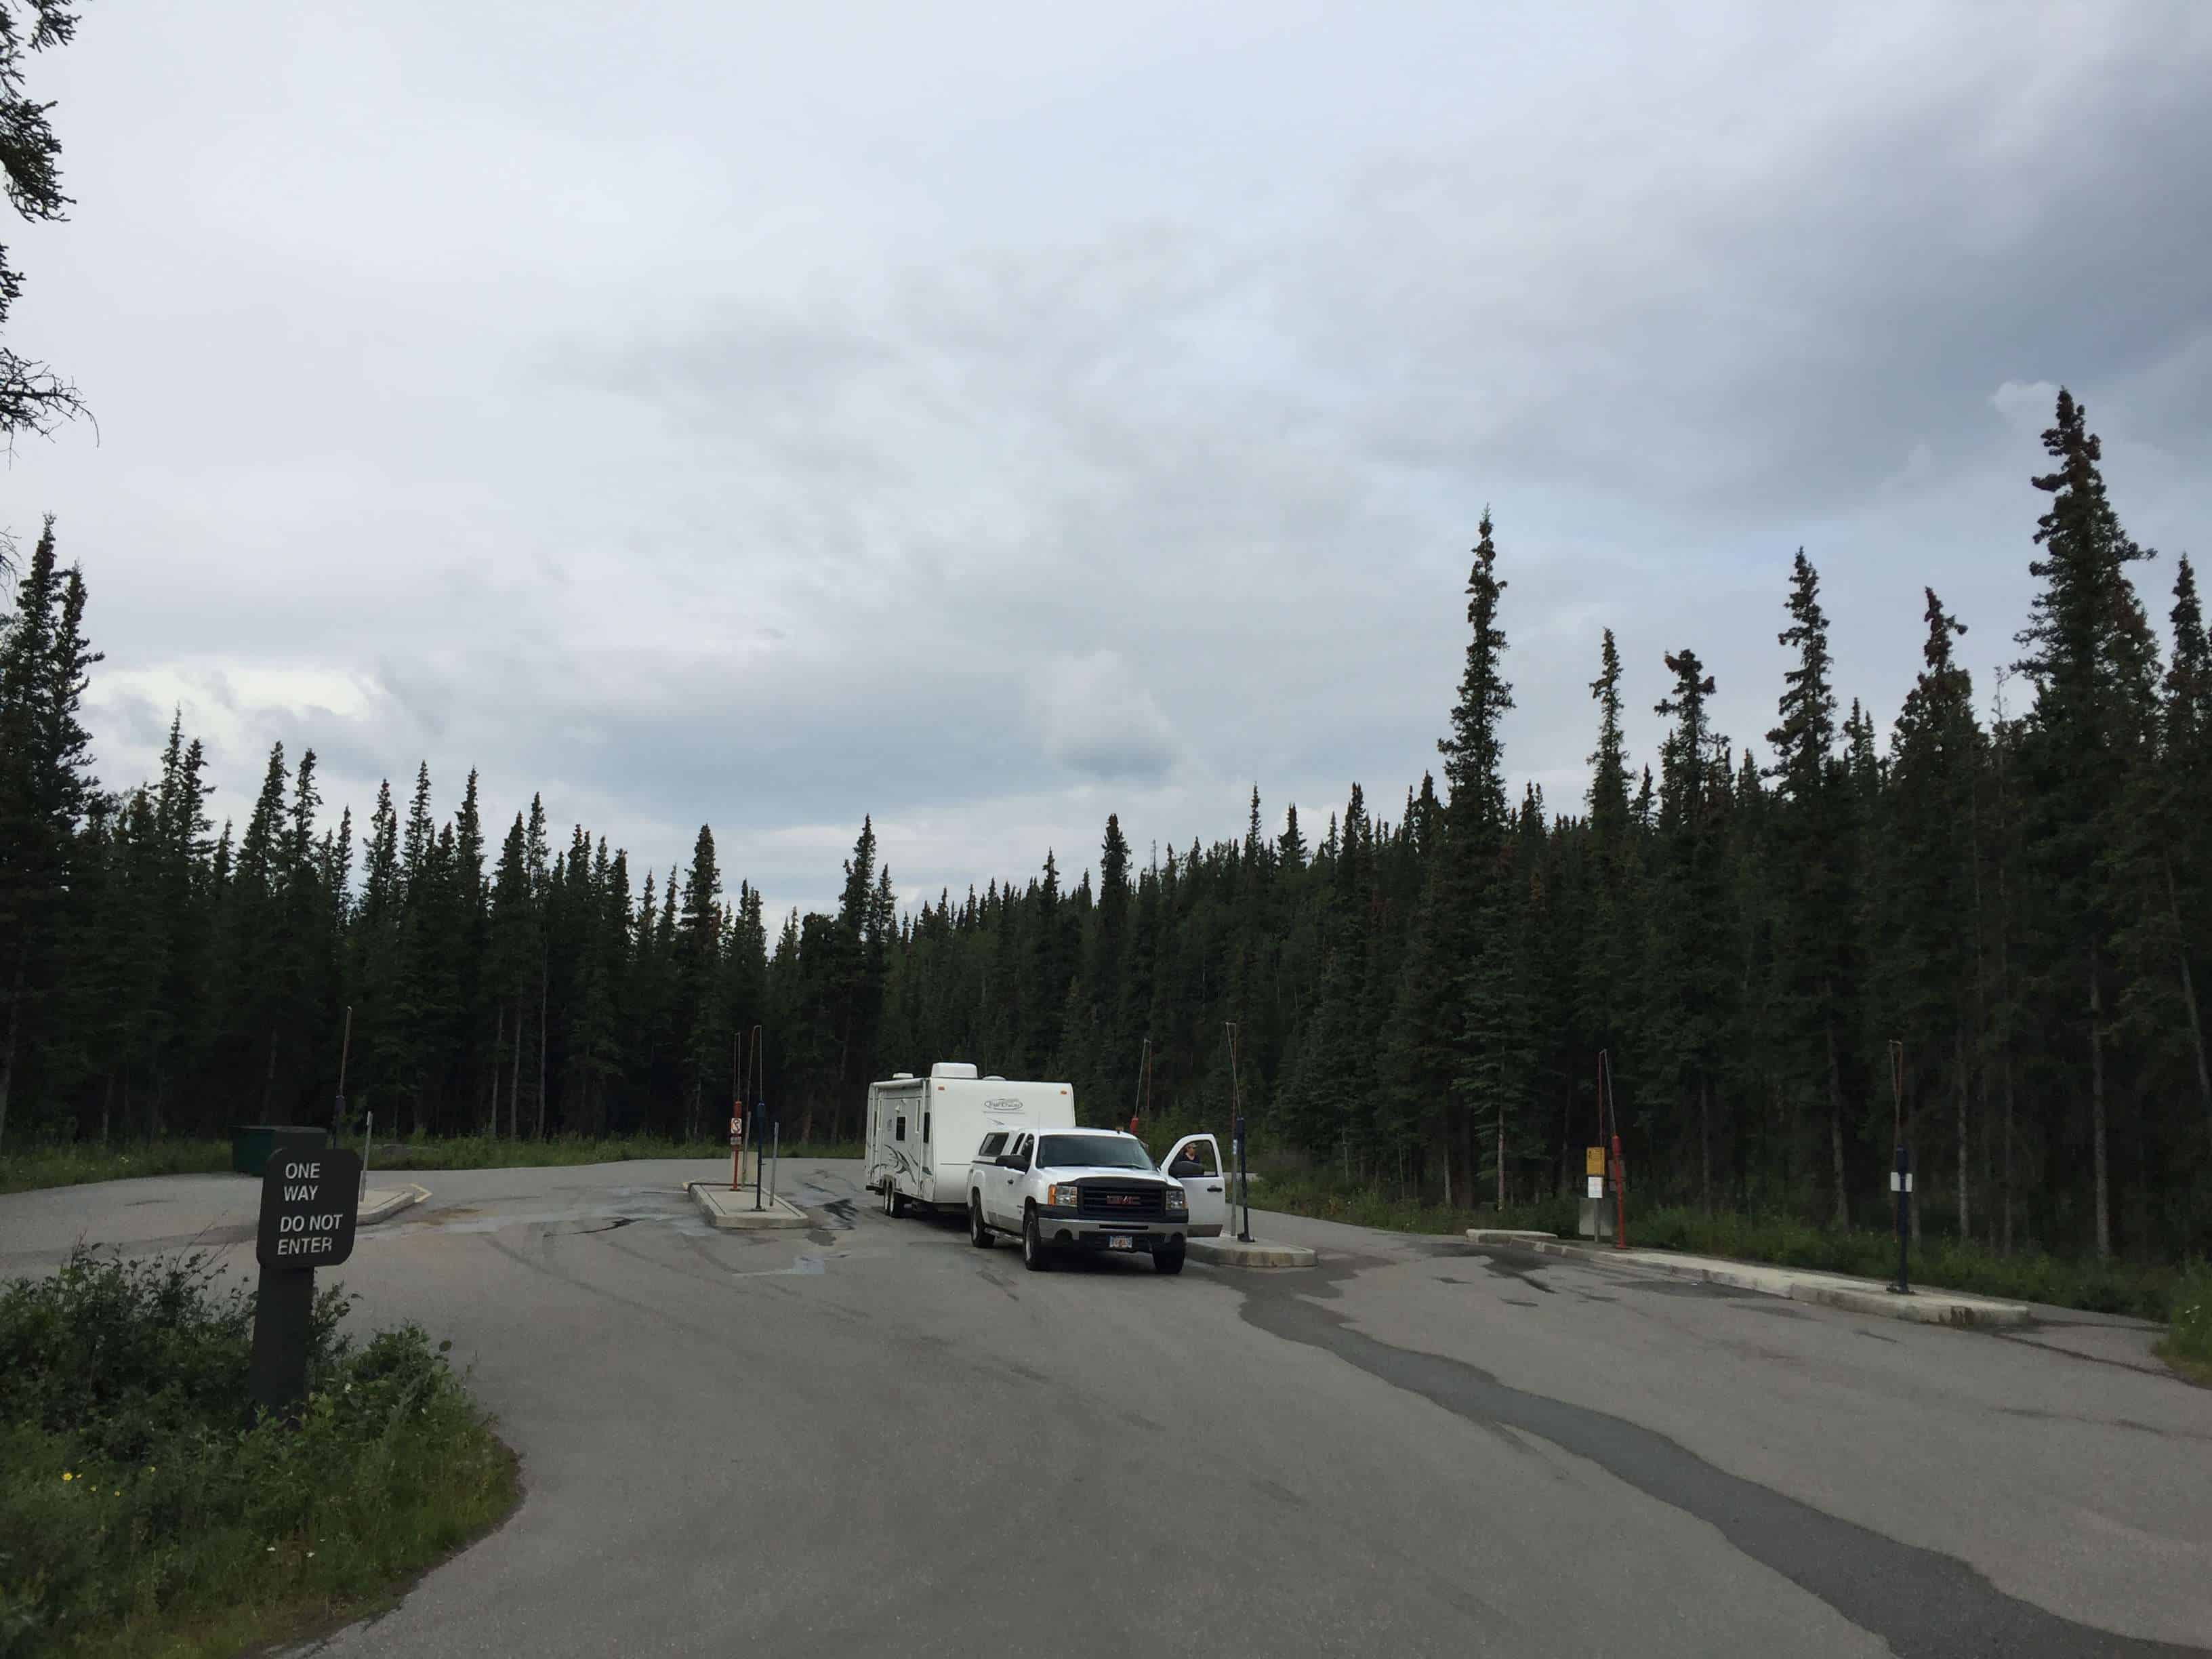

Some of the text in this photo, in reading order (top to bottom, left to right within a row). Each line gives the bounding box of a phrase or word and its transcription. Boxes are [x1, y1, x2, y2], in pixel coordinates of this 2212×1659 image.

[285, 1162, 321, 1179] ONE
[283, 1185, 319, 1202] WAY
[280, 1214, 344, 1233] DO NOT
[277, 1237, 333, 1255] ENTER
